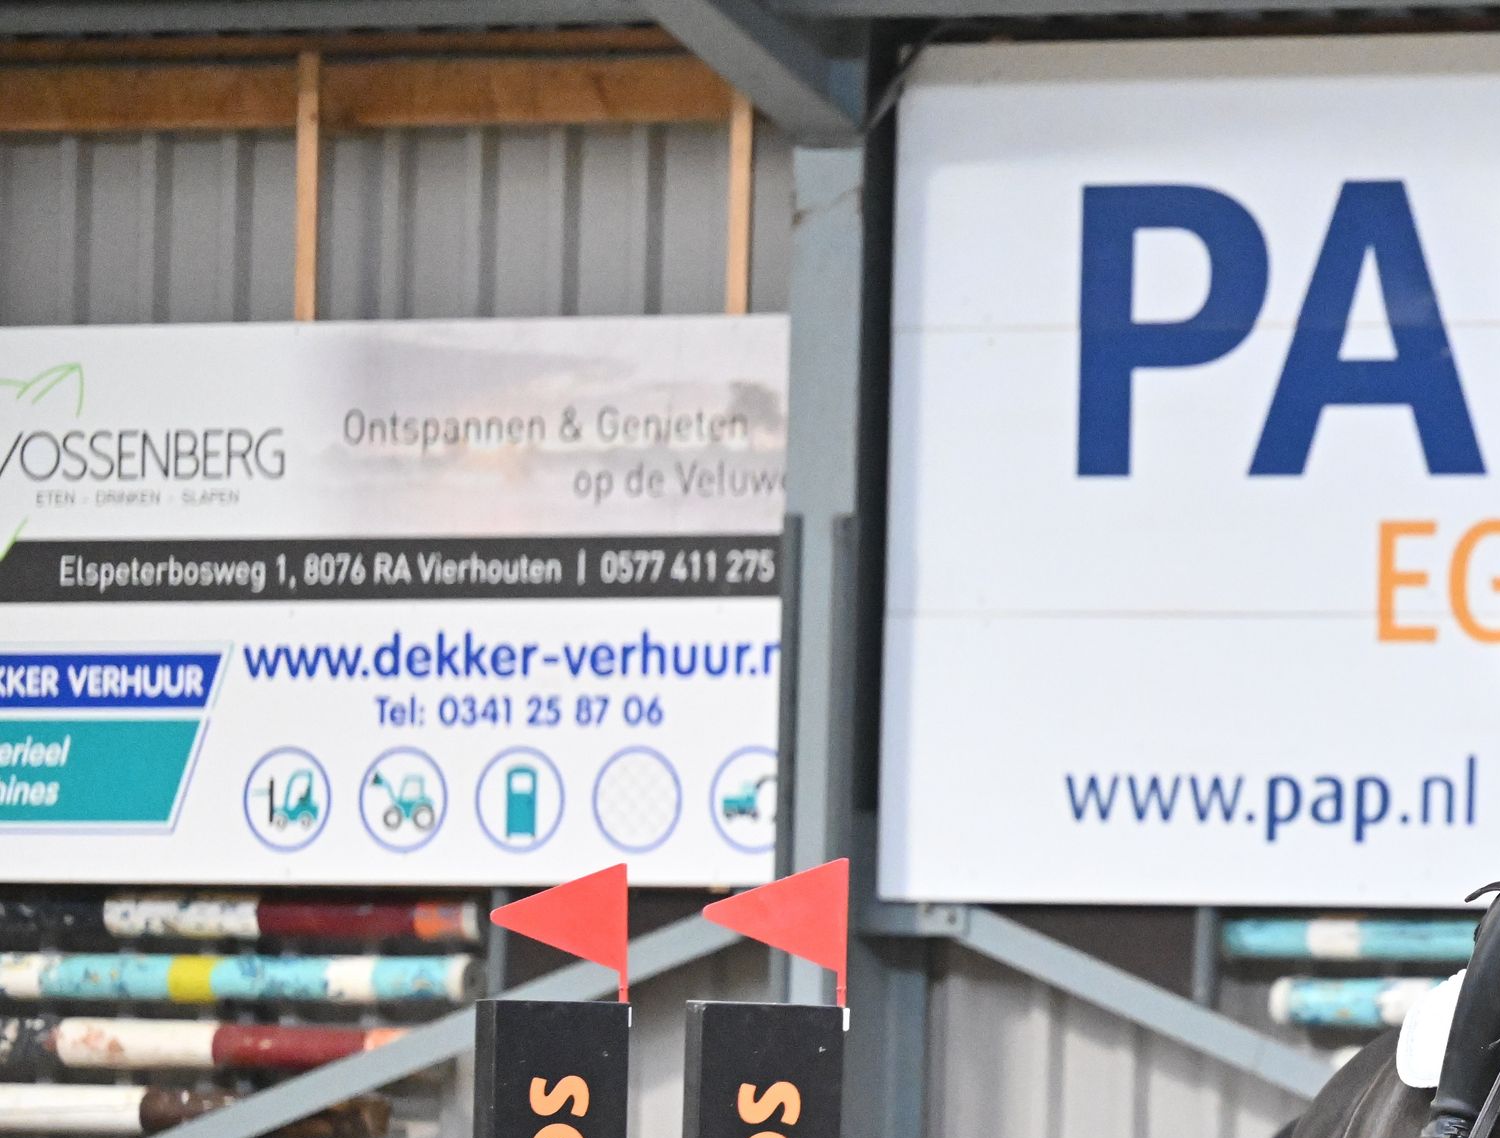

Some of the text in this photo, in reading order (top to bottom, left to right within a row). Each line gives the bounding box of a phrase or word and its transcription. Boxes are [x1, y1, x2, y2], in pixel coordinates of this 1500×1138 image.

[343, 404, 748, 457] Ontspannen & Genieten
[36, 490, 75, 507] ETEN
[573, 459, 787, 504] op de Veluw
[60, 555, 266, 593] Elspeterbosweg
[304, 552, 366, 585] 8076
[374, 552, 411, 585] RA
[417, 551, 562, 585] Vierhouten
[600, 549, 665, 584] 0577
[671, 549, 716, 582] 411
[726, 549, 775, 583] 275
[0, 665, 204, 698] KER VERHUUR
[375, 695, 664, 726] Tel: 0341 25 87 06
[1066, 755, 1477, 843] www.pap.nl
